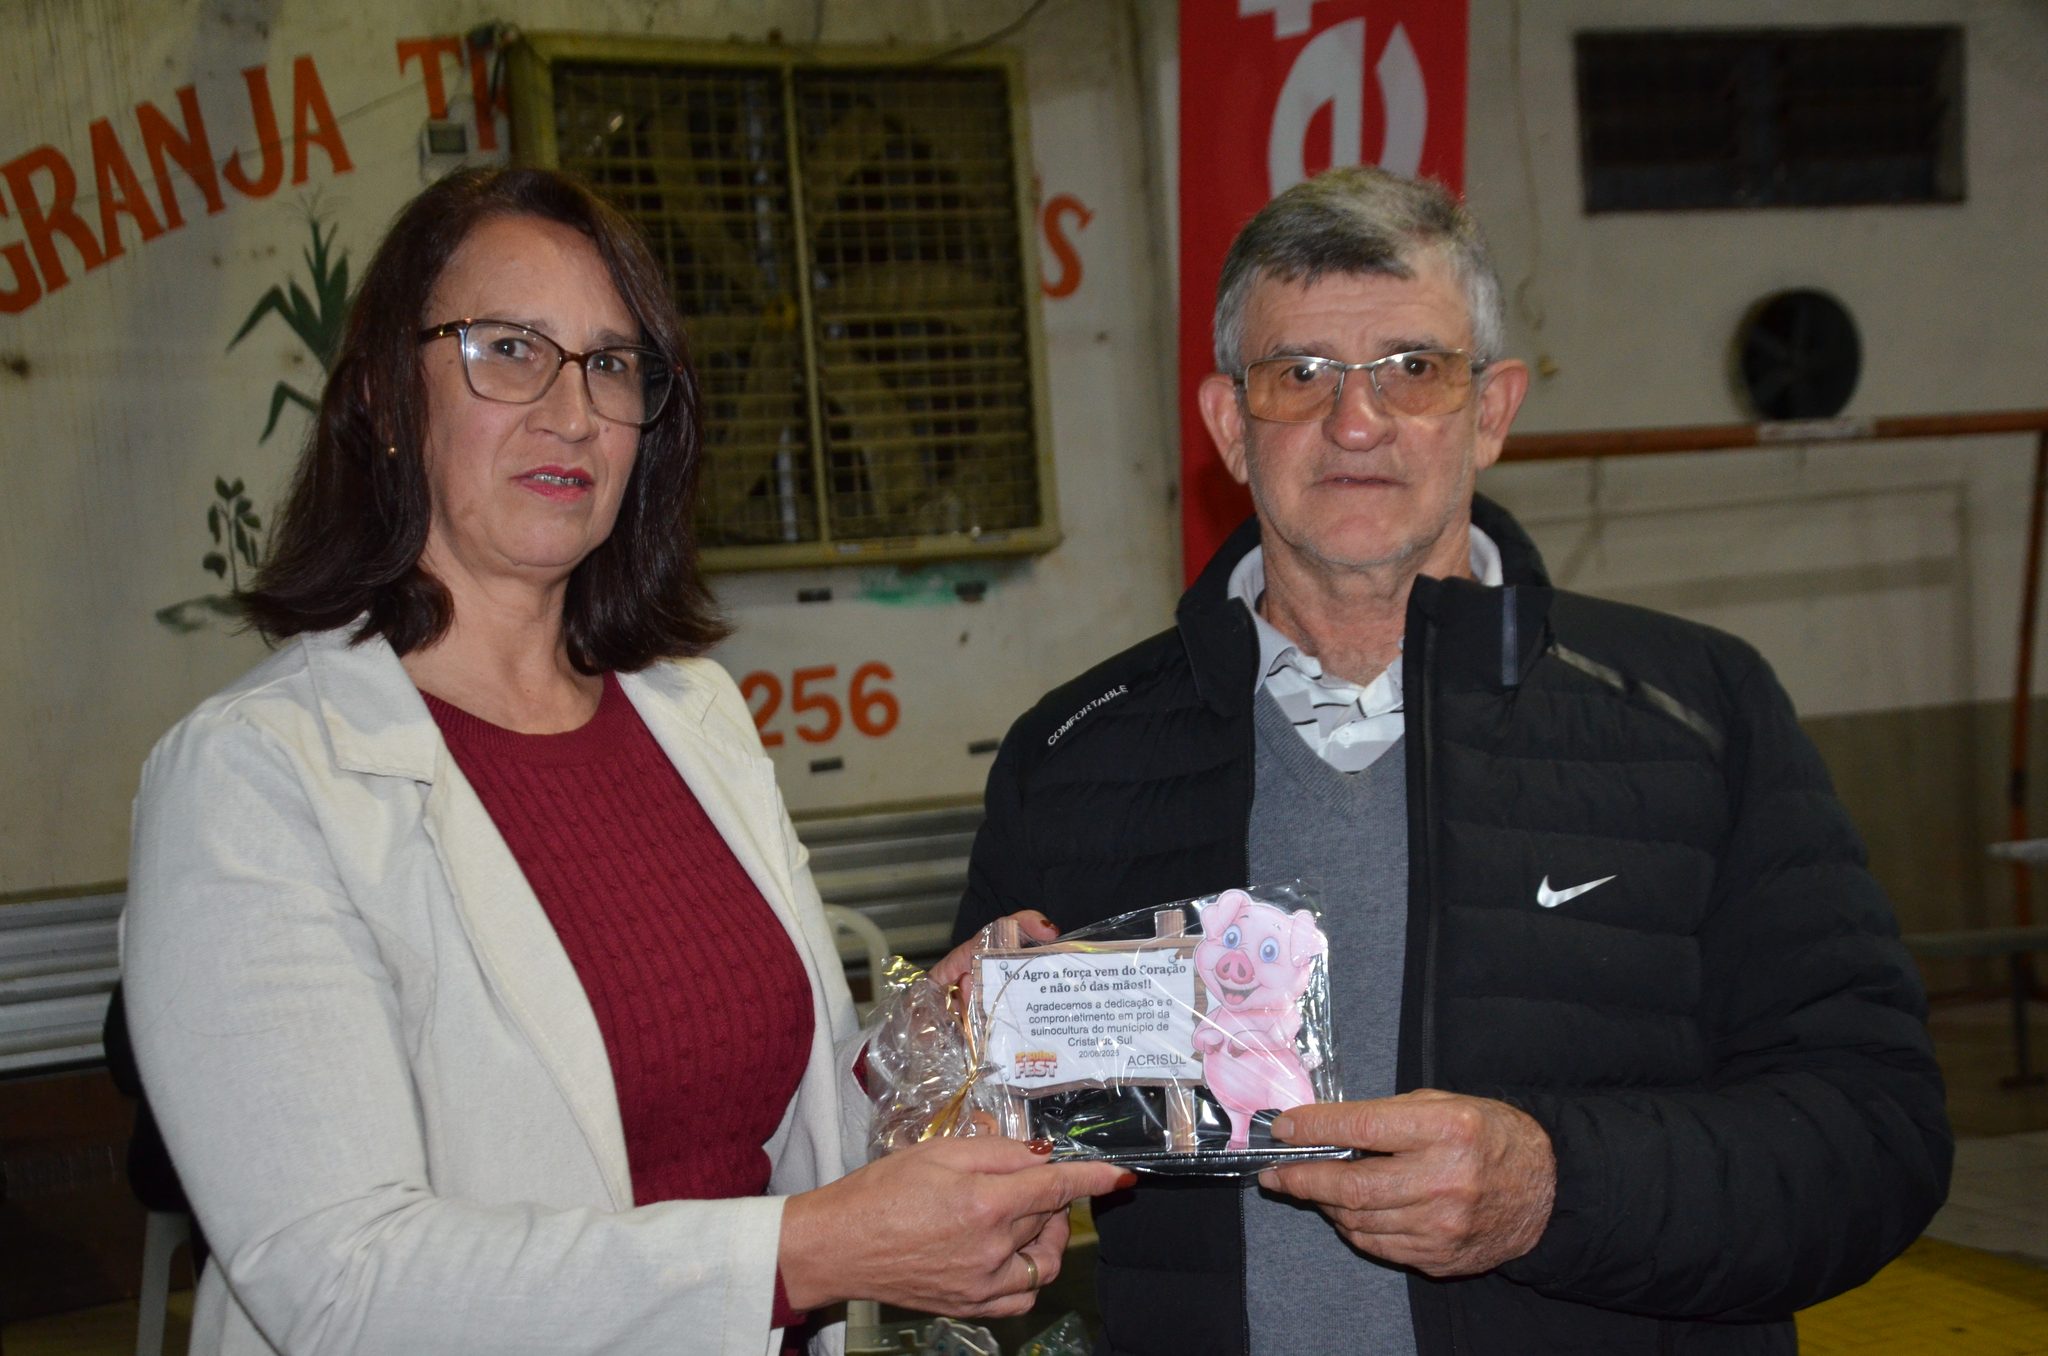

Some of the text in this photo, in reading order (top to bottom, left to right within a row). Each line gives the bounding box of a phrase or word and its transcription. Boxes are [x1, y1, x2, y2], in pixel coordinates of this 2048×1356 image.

[1047, 684, 1129, 746] COMFORTABLE
[1004, 970, 1020, 980] No
[1023, 970, 1050, 982] Agro
[1062, 968, 1092, 980] força
[1094, 968, 1119, 977] vem
[1121, 965, 1137, 976] do
[1139, 964, 1187, 976] Coração
[1040, 979, 1152, 994] e não só das mãos!!
[1025, 998, 1173, 1014] Agradecemos a dedicação e o
[1028, 1009, 1170, 1025] comprometimento em prol da
[1030, 1026, 1089, 1037] suinocultura
[1091, 1024, 1104, 1033] do
[1156, 1021, 1169, 1031] de
[1067, 1036, 1099, 1047] Cristal
[1116, 1034, 1133, 1045] Sul
[1015, 1052, 1187, 1079] FEST ACRISUL
